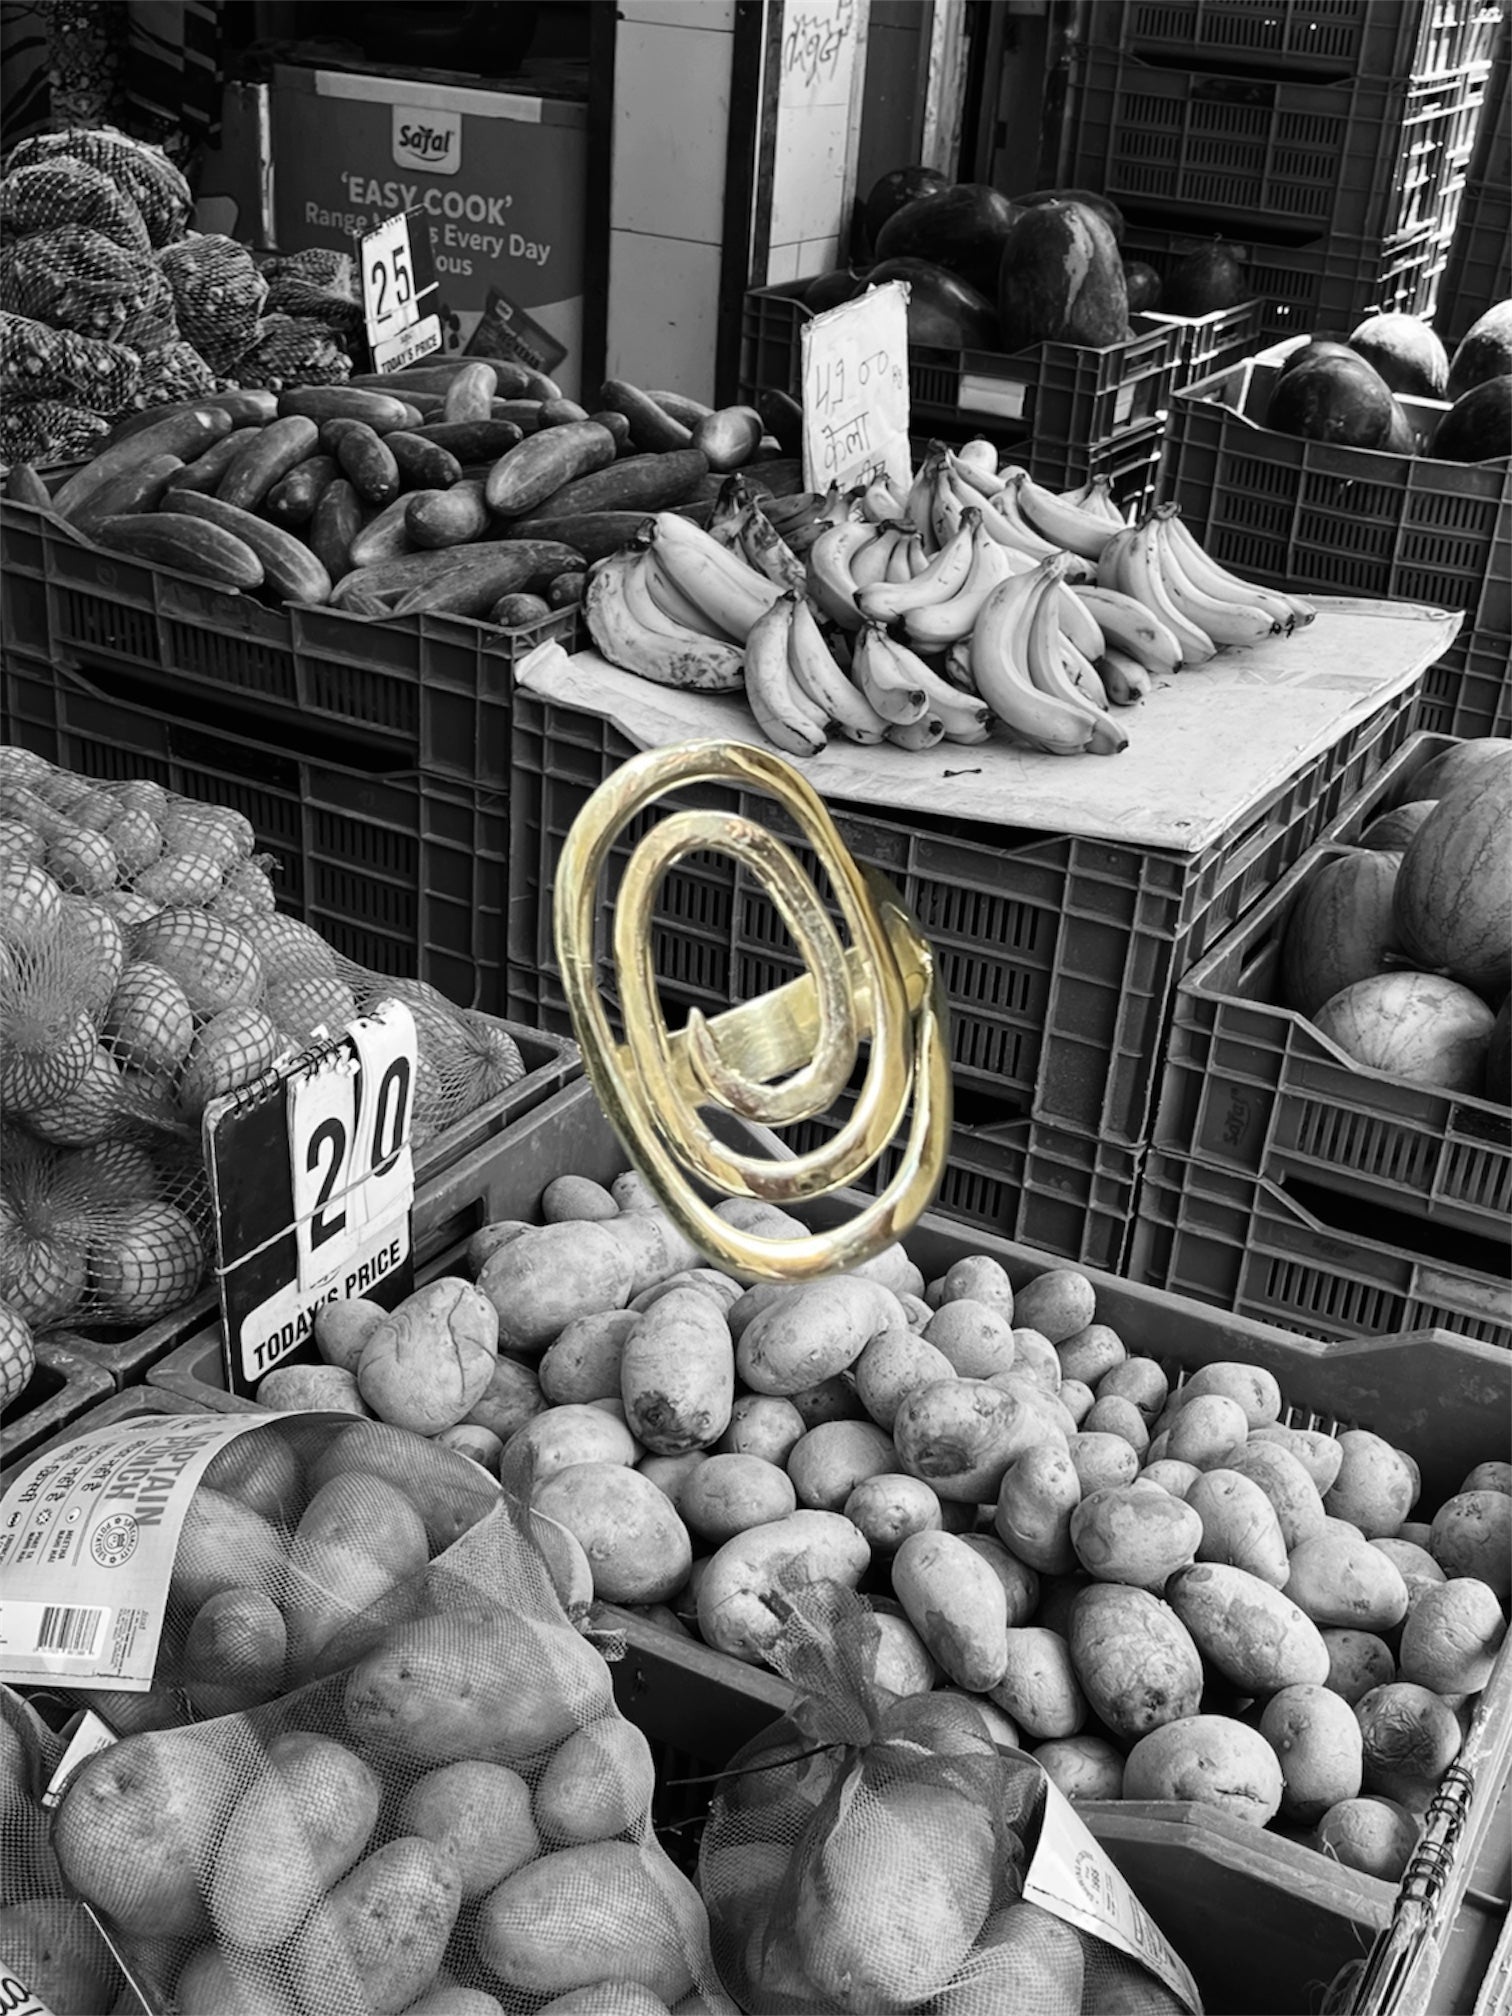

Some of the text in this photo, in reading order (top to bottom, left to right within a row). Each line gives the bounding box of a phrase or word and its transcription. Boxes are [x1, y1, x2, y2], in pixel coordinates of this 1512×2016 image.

[398, 124, 452, 155] Safal
[305, 201, 368, 235] Range
[443, 223, 503, 258] Every
[509, 234, 552, 266] Day
[423, 187, 513, 227] COOK’
[371, 246, 411, 324] 25
[821, 410, 871, 473] केला
[306, 1055, 410, 1253] 20
[344, 1238, 402, 1301] PRICE
[104, 1435, 186, 1499] PUNCH
[134, 1430, 223, 1526] CAPTAIN
[94, 1521, 112, 1562] POTATOES
